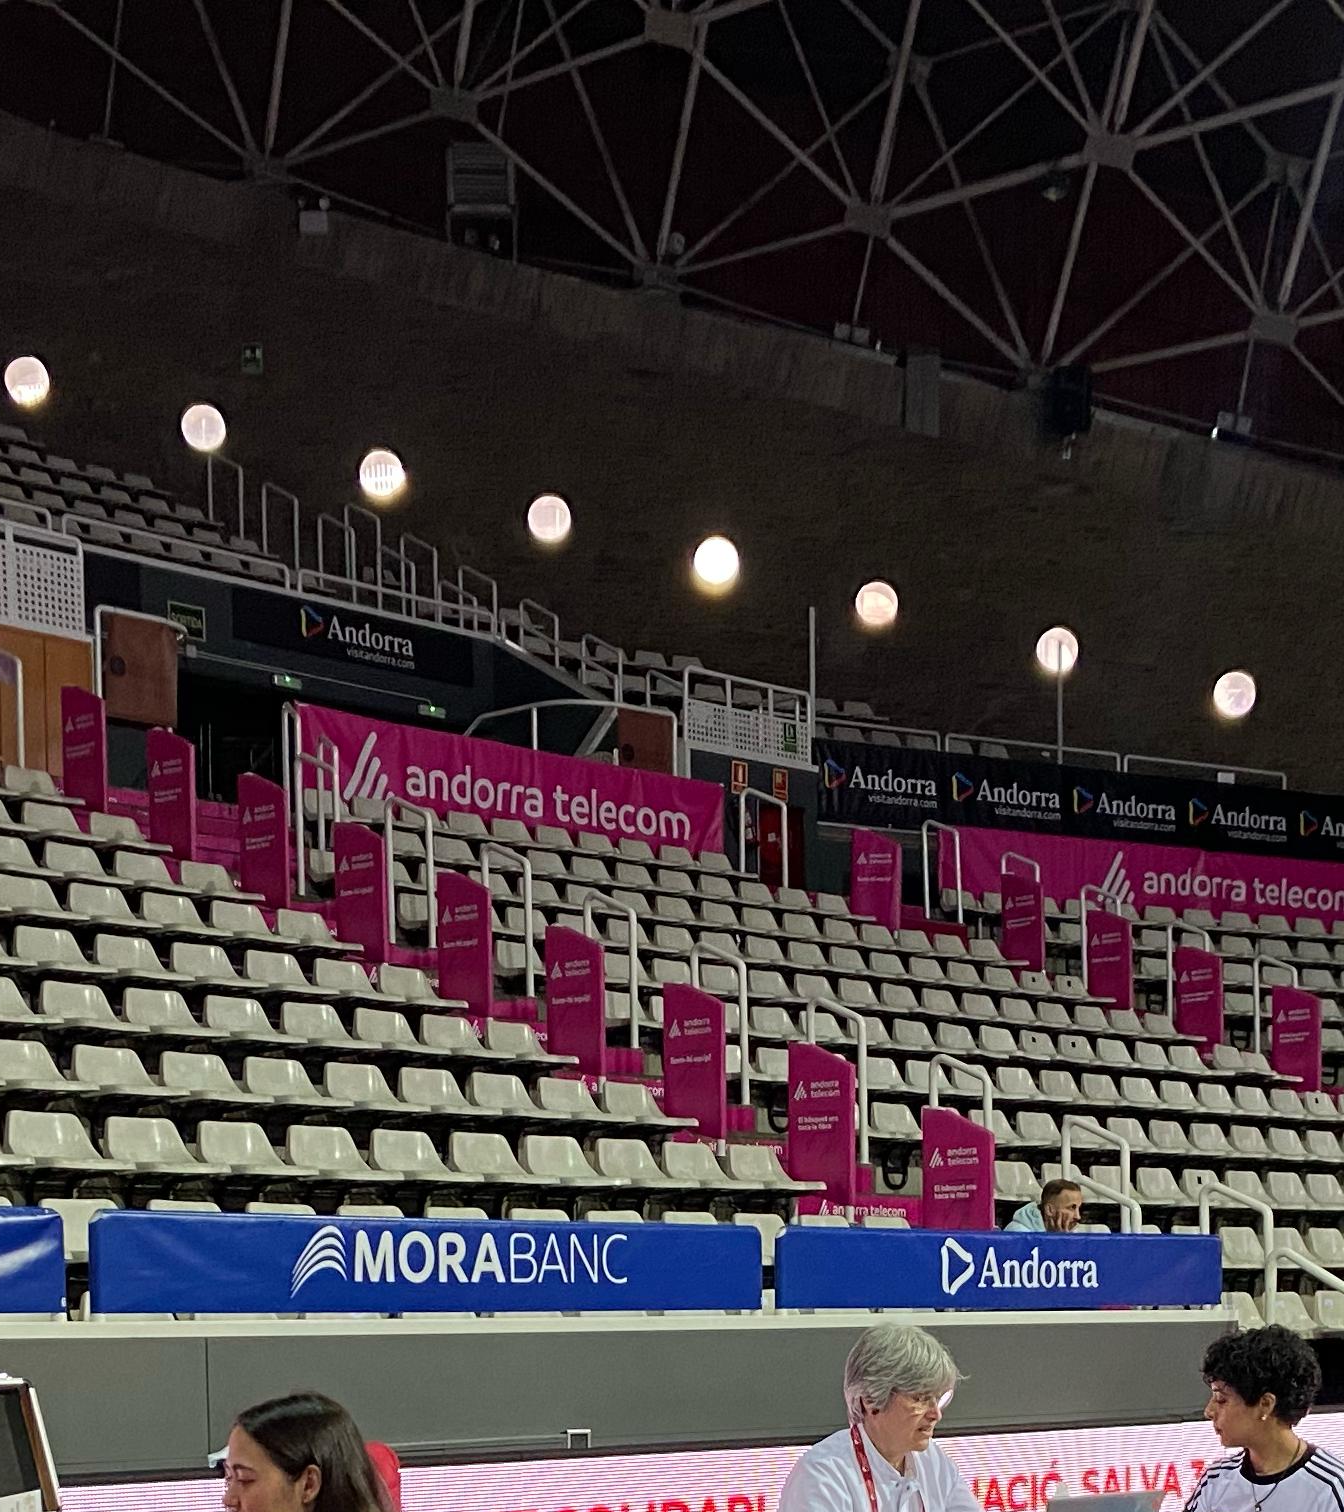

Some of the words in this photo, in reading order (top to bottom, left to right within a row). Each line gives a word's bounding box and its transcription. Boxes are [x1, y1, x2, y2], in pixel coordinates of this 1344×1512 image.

[327, 615, 414, 657] Andorra
[346, 647, 415, 670] visitandorra.com
[848, 766, 937, 796] Andorra
[976, 779, 1060, 809] Andorra
[406, 764, 544, 819] andorra
[553, 784, 691, 845] telecom
[868, 793, 938, 809] visitandorra.com
[994, 805, 1061, 821] visitandorra.com
[1096, 792, 1176, 820] Andorra
[1211, 803, 1288, 832] Andorra
[1143, 867, 1248, 902] andorra
[832, 1205, 869, 1216] anrra
[870, 1204, 906, 1216] telecom
[354, 1230, 628, 1285] MORABANC
[977, 1245, 1099, 1290] Andorra
